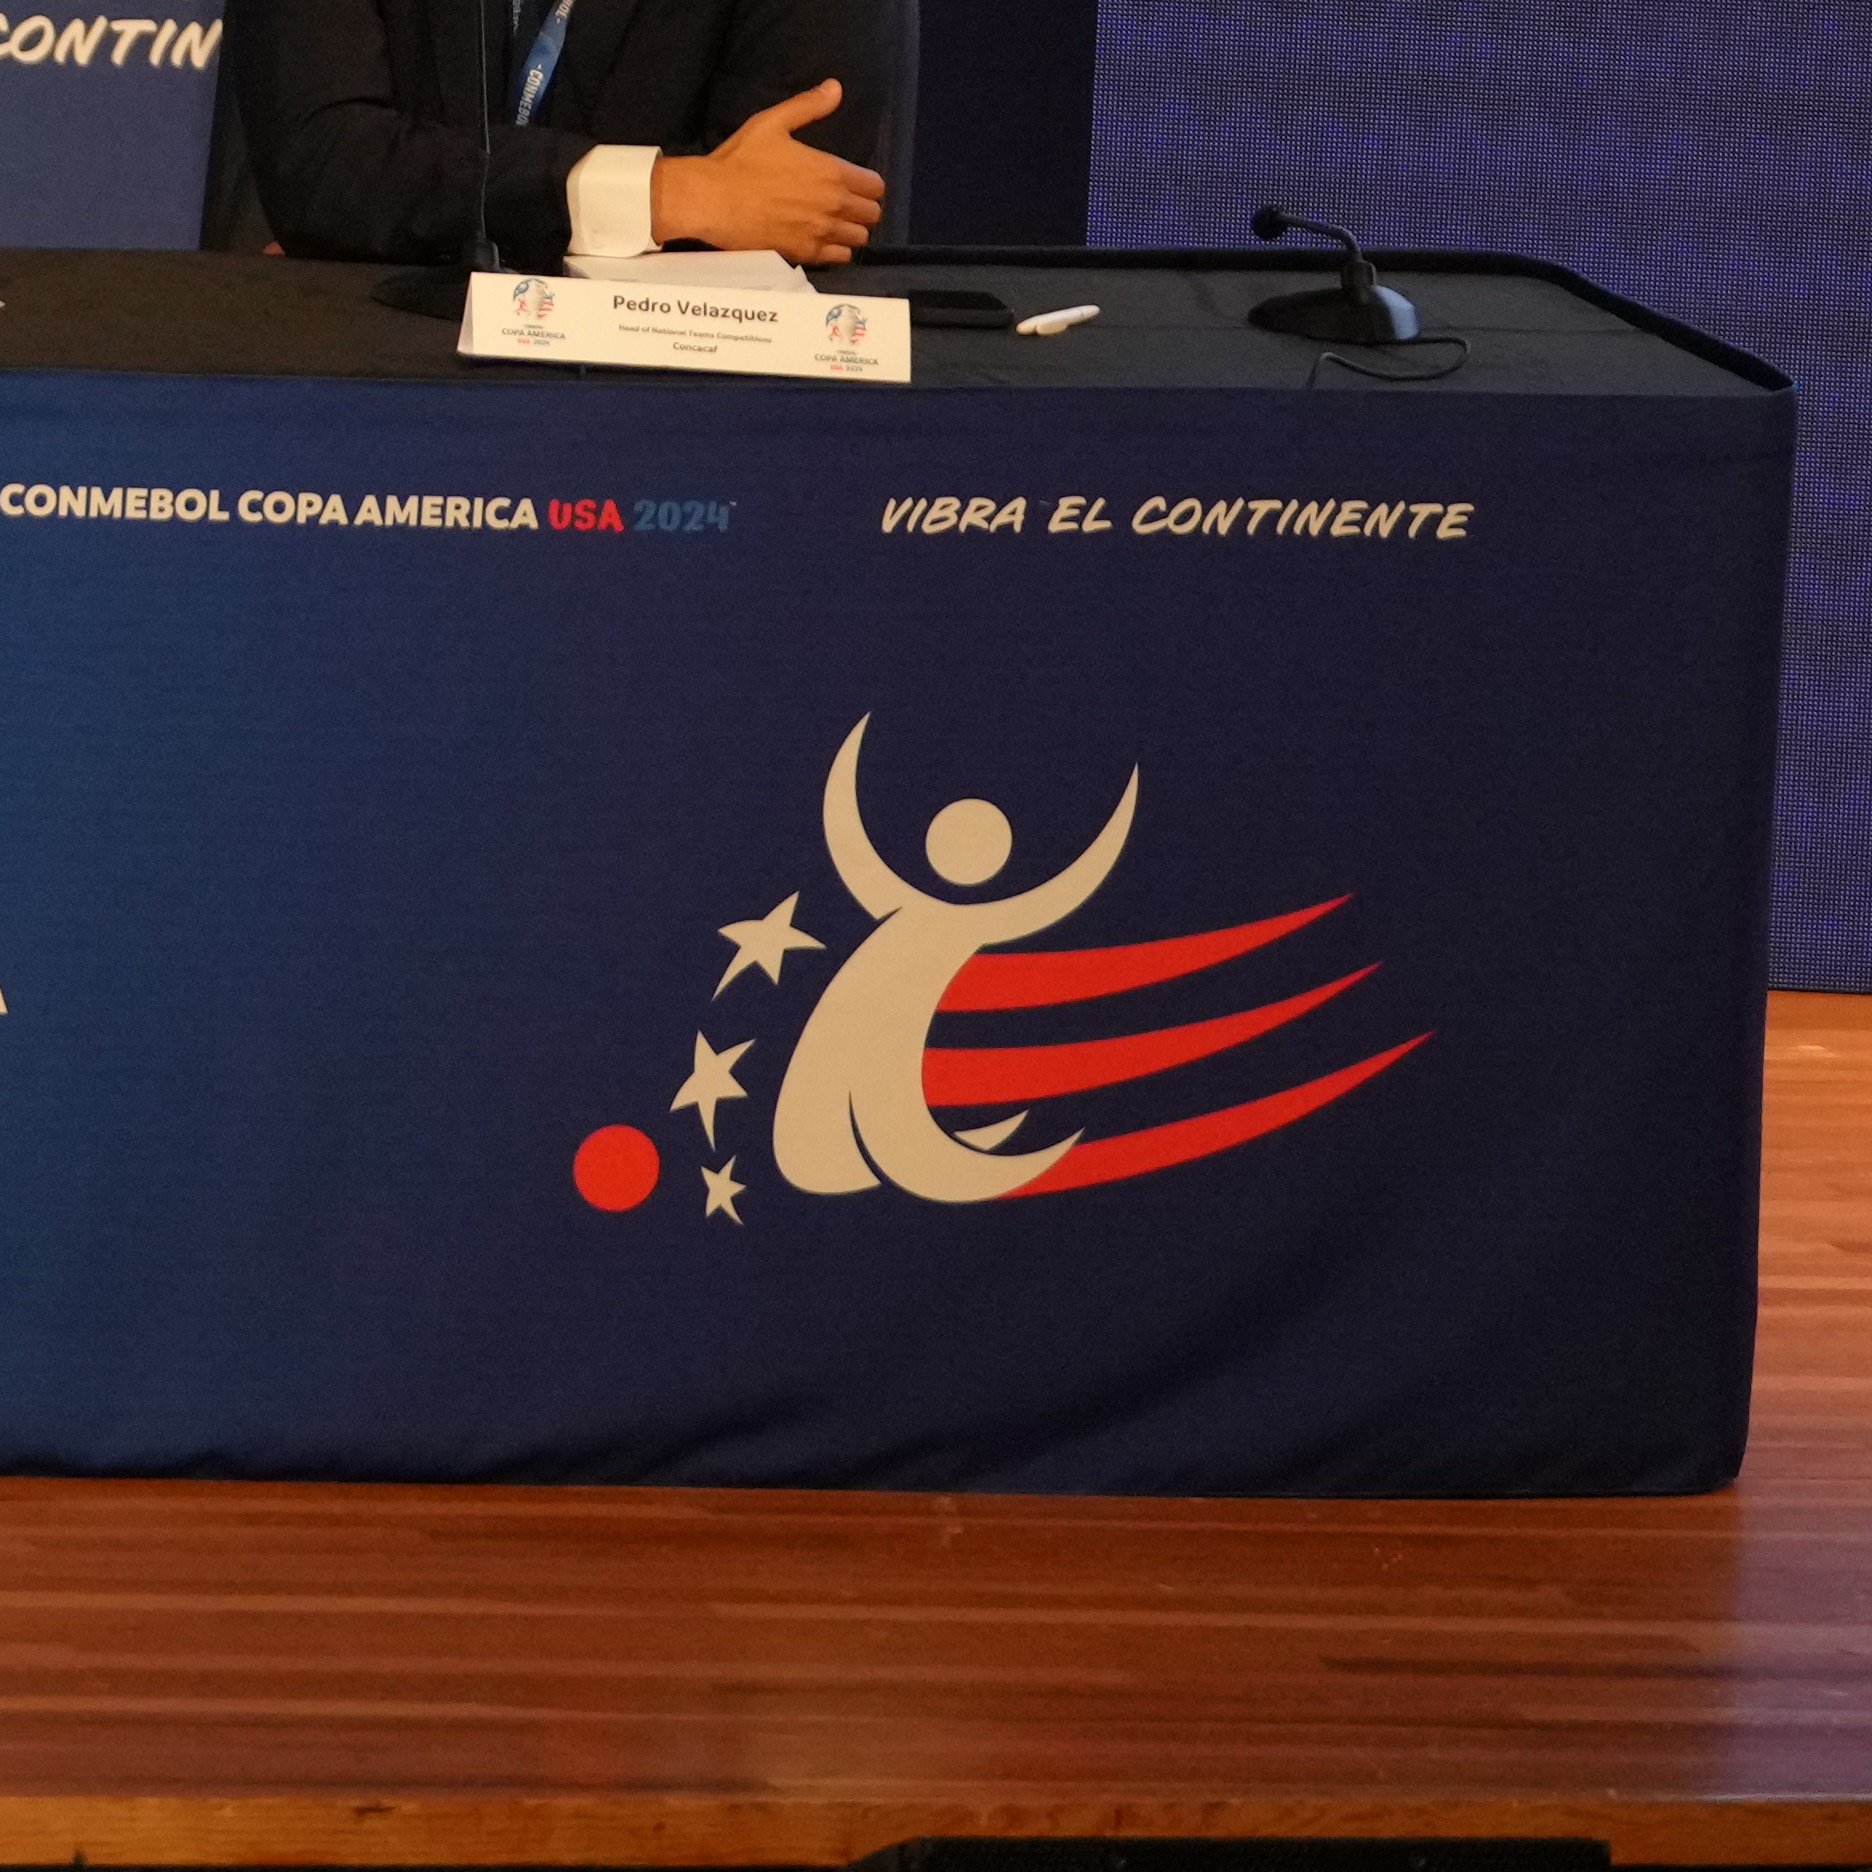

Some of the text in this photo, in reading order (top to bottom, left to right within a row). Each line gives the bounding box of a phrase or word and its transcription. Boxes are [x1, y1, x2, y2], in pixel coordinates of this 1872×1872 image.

[612, 294, 779, 324] Pedro Velazquez
[672, 340, 718, 354] Concacaf
[236, 489, 350, 526] COPA
[353, 494, 540, 530] AMERICA
[547, 498, 625, 533] USA
[633, 498, 729, 534] 2024
[881, 495, 1475, 540] VIBRA EL CONTINENTE
